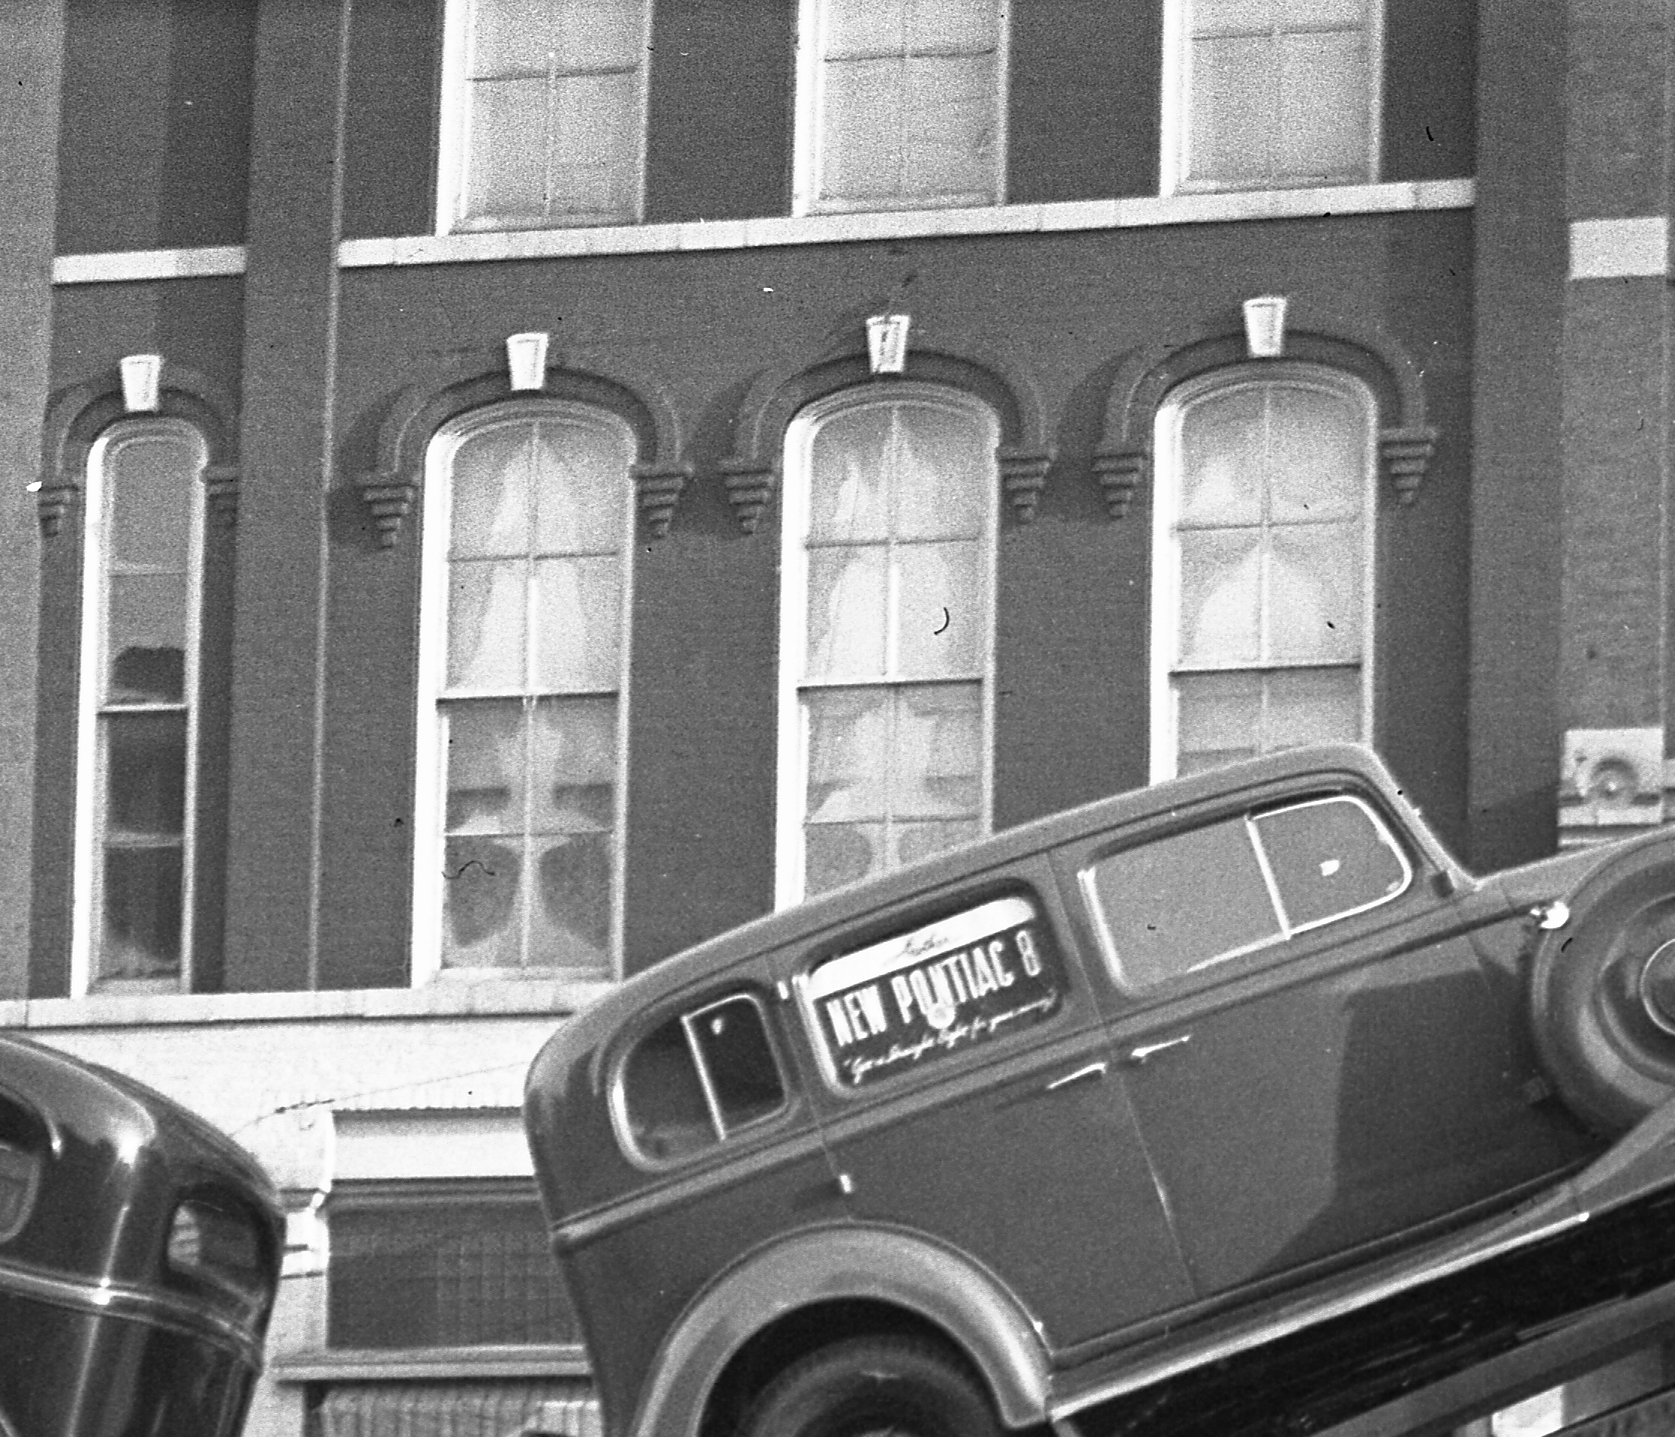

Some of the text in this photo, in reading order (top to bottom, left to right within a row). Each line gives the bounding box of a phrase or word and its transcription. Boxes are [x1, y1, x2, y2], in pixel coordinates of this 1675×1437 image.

[826, 984, 887, 1047] NEW
[892, 940, 1014, 1024] PONTIAC
[1016, 929, 1041, 977] 8
